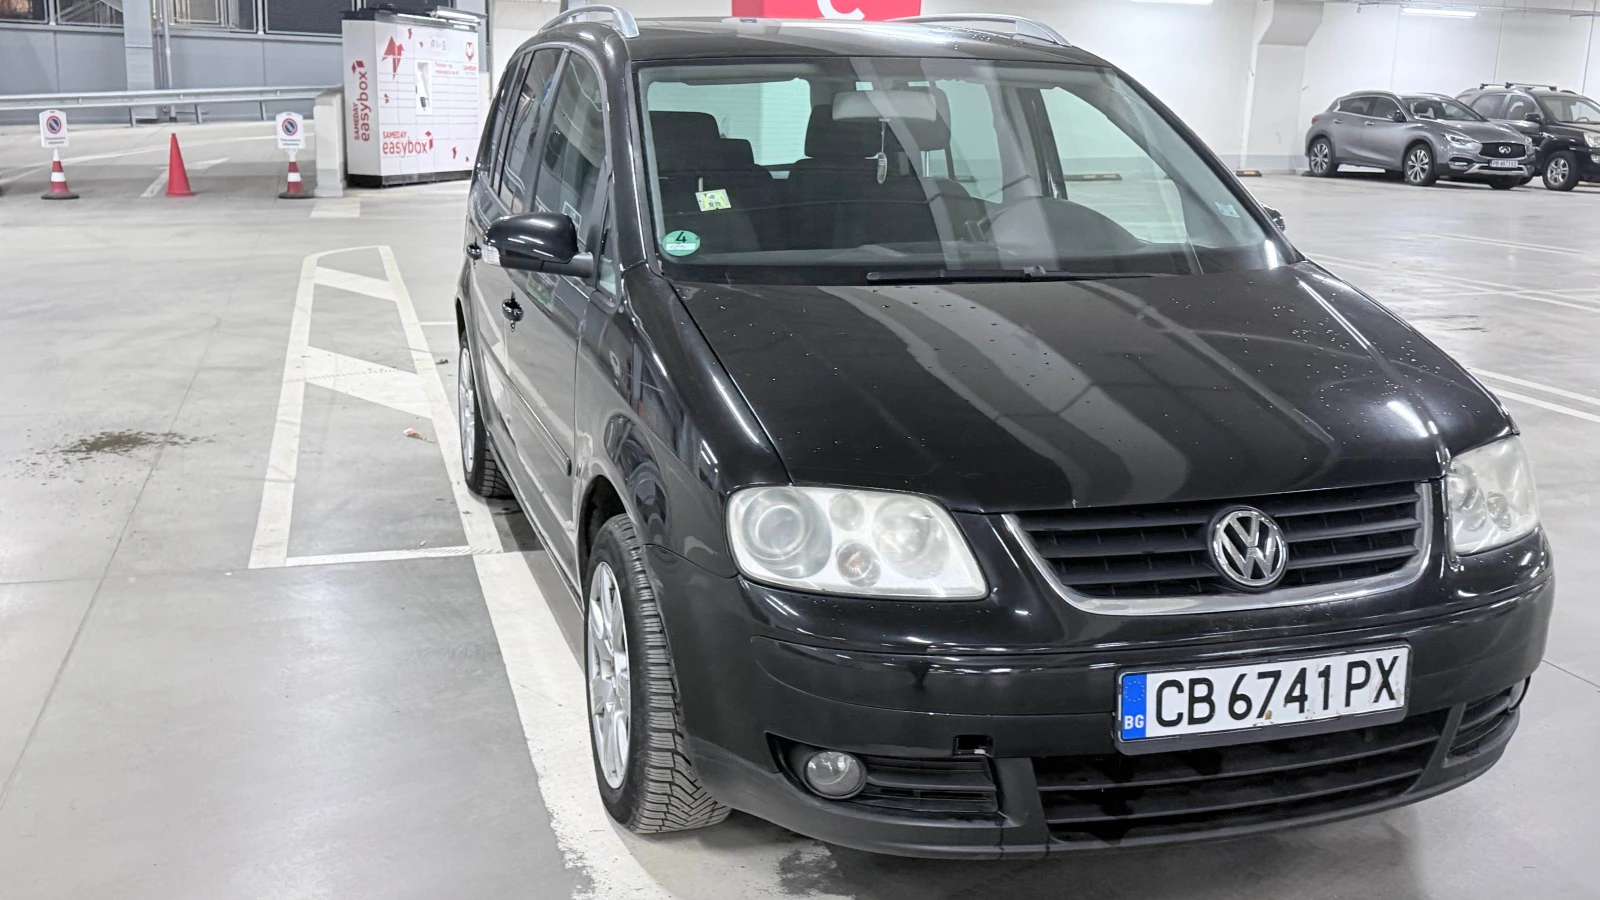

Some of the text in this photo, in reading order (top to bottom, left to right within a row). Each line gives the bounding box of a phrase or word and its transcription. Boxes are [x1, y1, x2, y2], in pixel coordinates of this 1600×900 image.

[357, 71, 371, 142] easybox
[382, 130, 407, 139] SAMEDAY
[382, 138, 428, 157] easybox
[675, 231, 687, 243] 4
[1155, 655, 1400, 728] CB 6741 PX
[1124, 714, 1145, 730] BG
